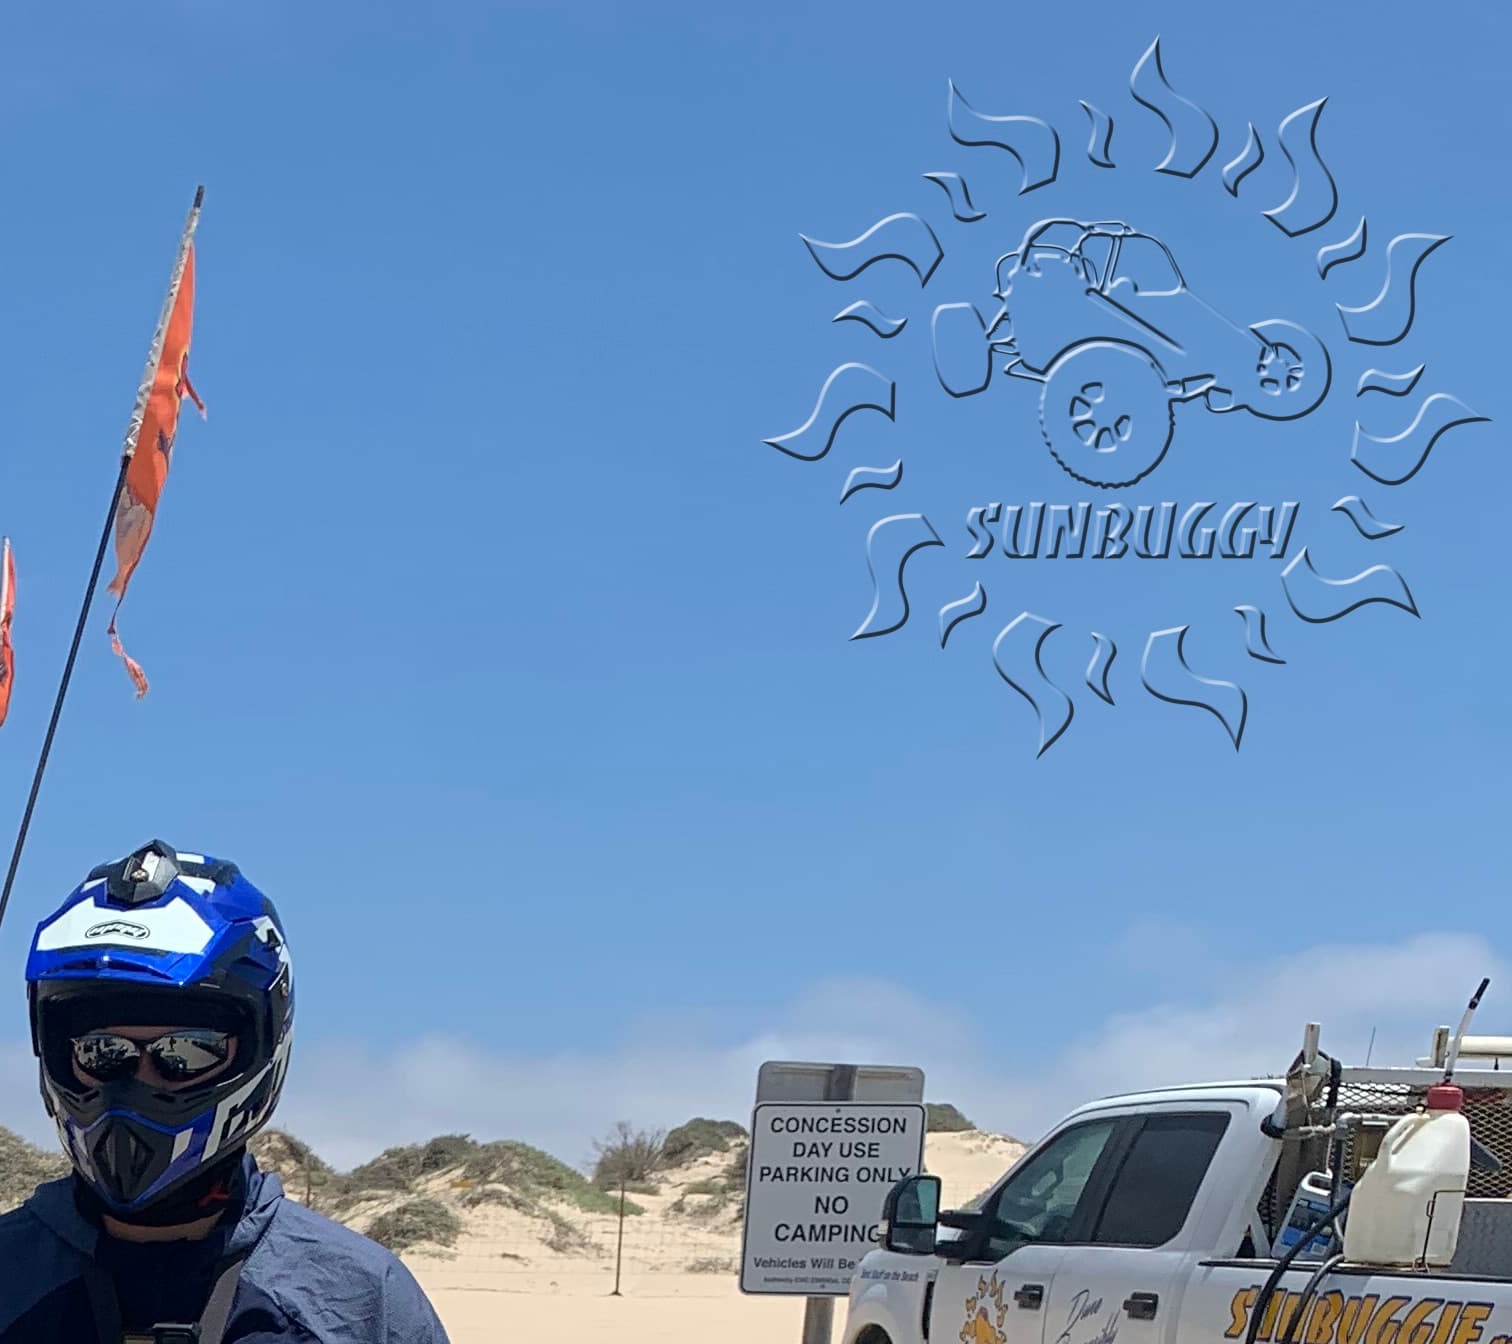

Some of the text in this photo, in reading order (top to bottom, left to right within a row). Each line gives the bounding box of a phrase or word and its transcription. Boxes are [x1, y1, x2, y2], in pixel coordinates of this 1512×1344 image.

[770, 1116, 907, 1134] CONCESSION
[792, 1142, 880, 1158] DAY USE
[759, 1166, 911, 1183] PARKING ONLY
[814, 1196, 849, 1214] NO
[774, 1223, 882, 1243] CAMPING
[753, 1257, 806, 1269] Vehicles
[810, 1257, 834, 1269] Will
[838, 1258, 856, 1270] Be
